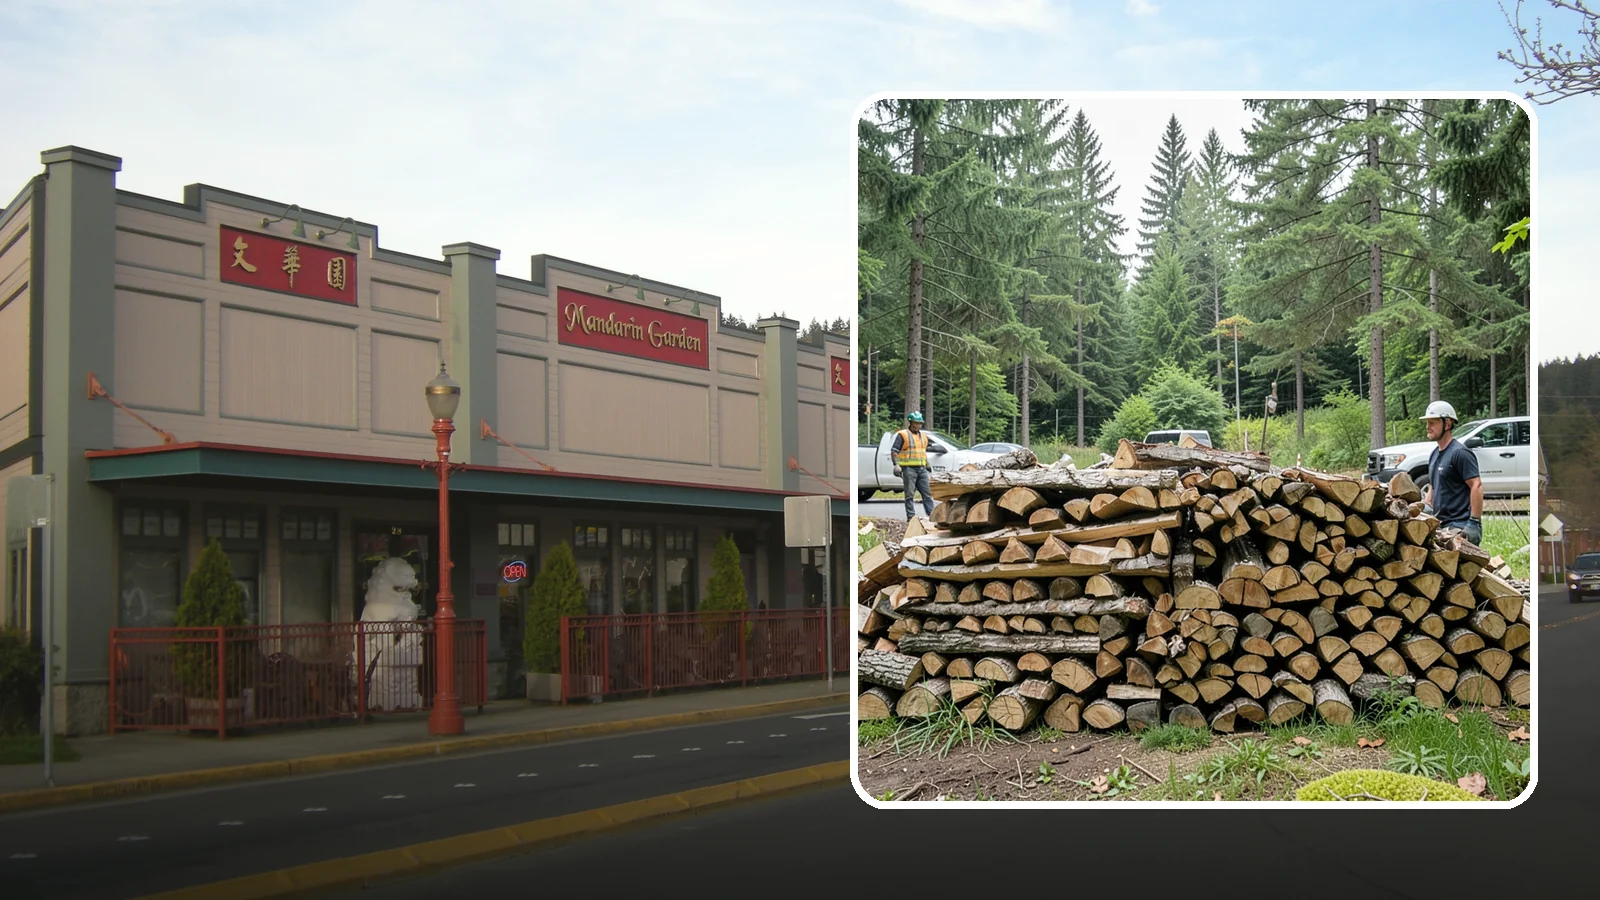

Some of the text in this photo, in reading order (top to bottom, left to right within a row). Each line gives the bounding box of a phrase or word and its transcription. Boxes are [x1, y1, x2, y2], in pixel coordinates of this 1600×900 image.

[231, 236, 346, 290] 文華園
[565, 302, 701, 352] Mandarin Garden
[834, 363, 846, 386] 文
[503, 565, 526, 578] OPEN
